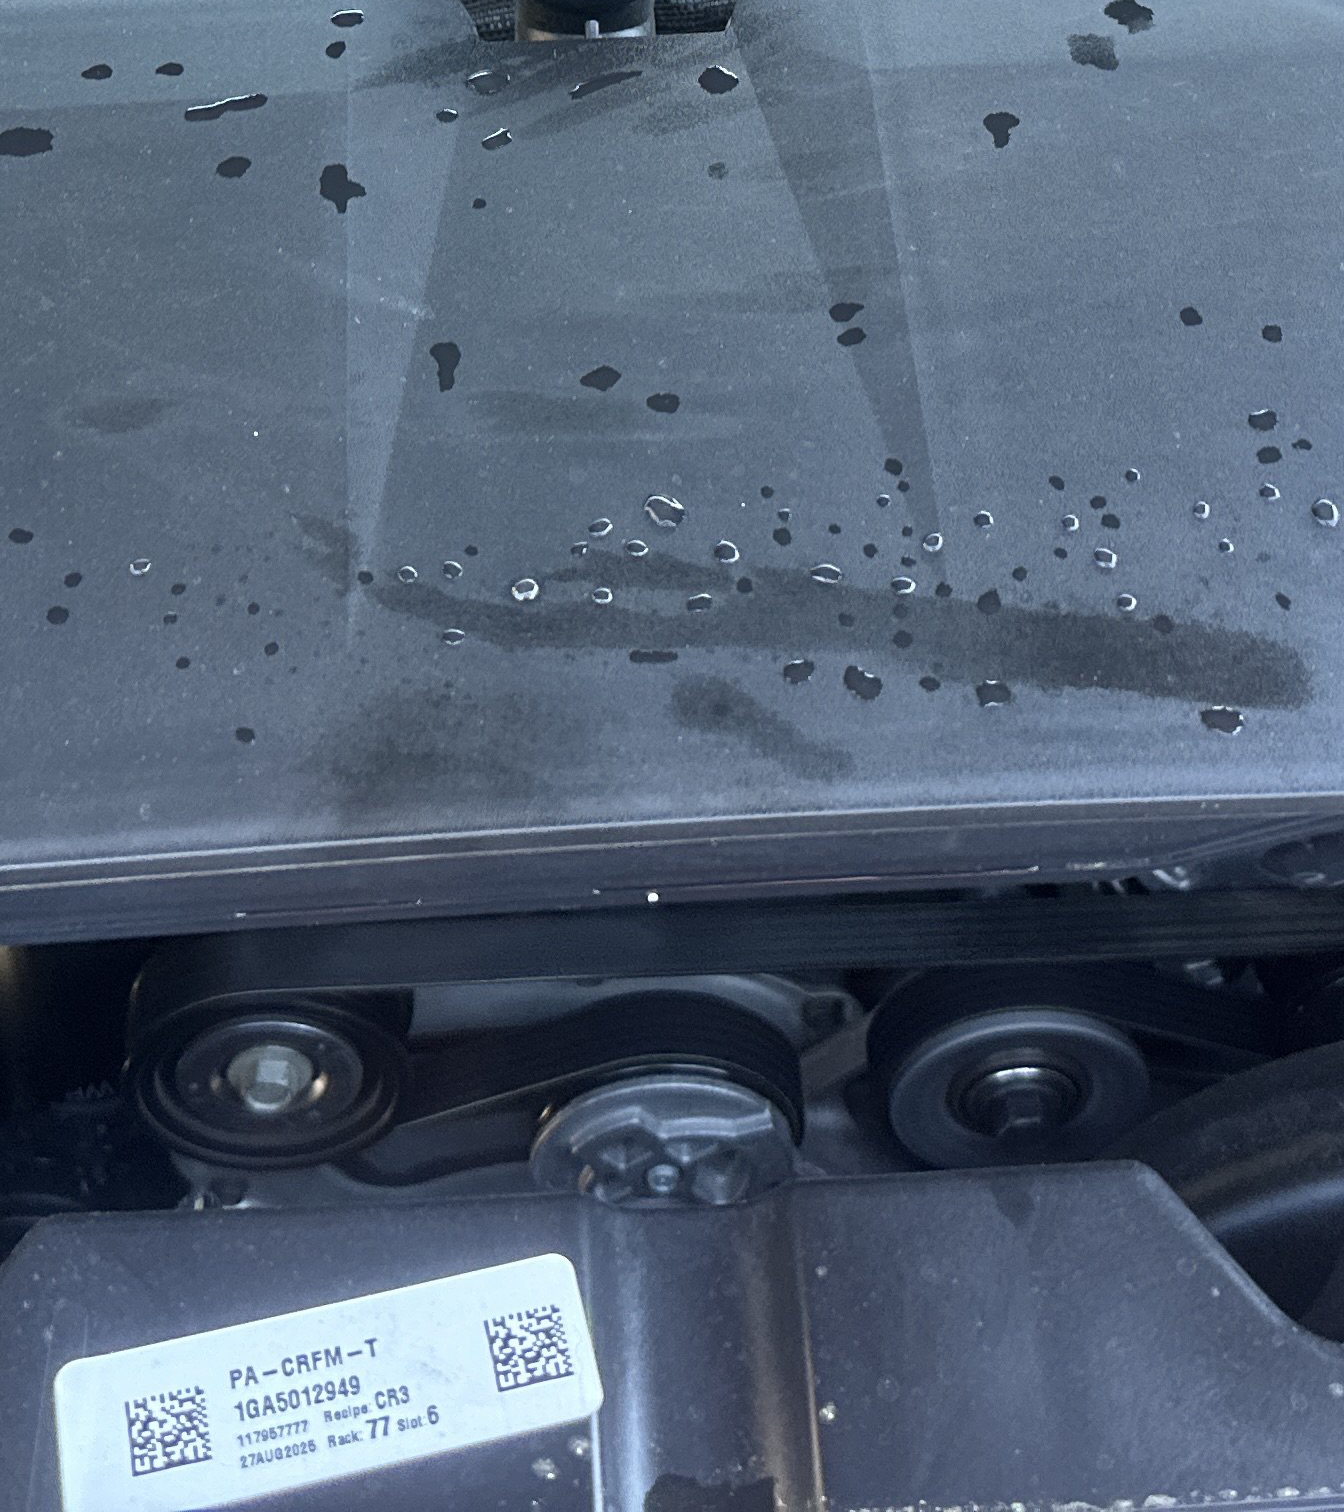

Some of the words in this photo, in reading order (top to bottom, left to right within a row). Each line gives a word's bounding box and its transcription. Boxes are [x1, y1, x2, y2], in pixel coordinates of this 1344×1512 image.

[234, 1375, 360, 1421] 1GA5012949
[374, 1385, 410, 1410] CR3
[365, 1415, 390, 1439] 77
[426, 1404, 440, 1425] 6
